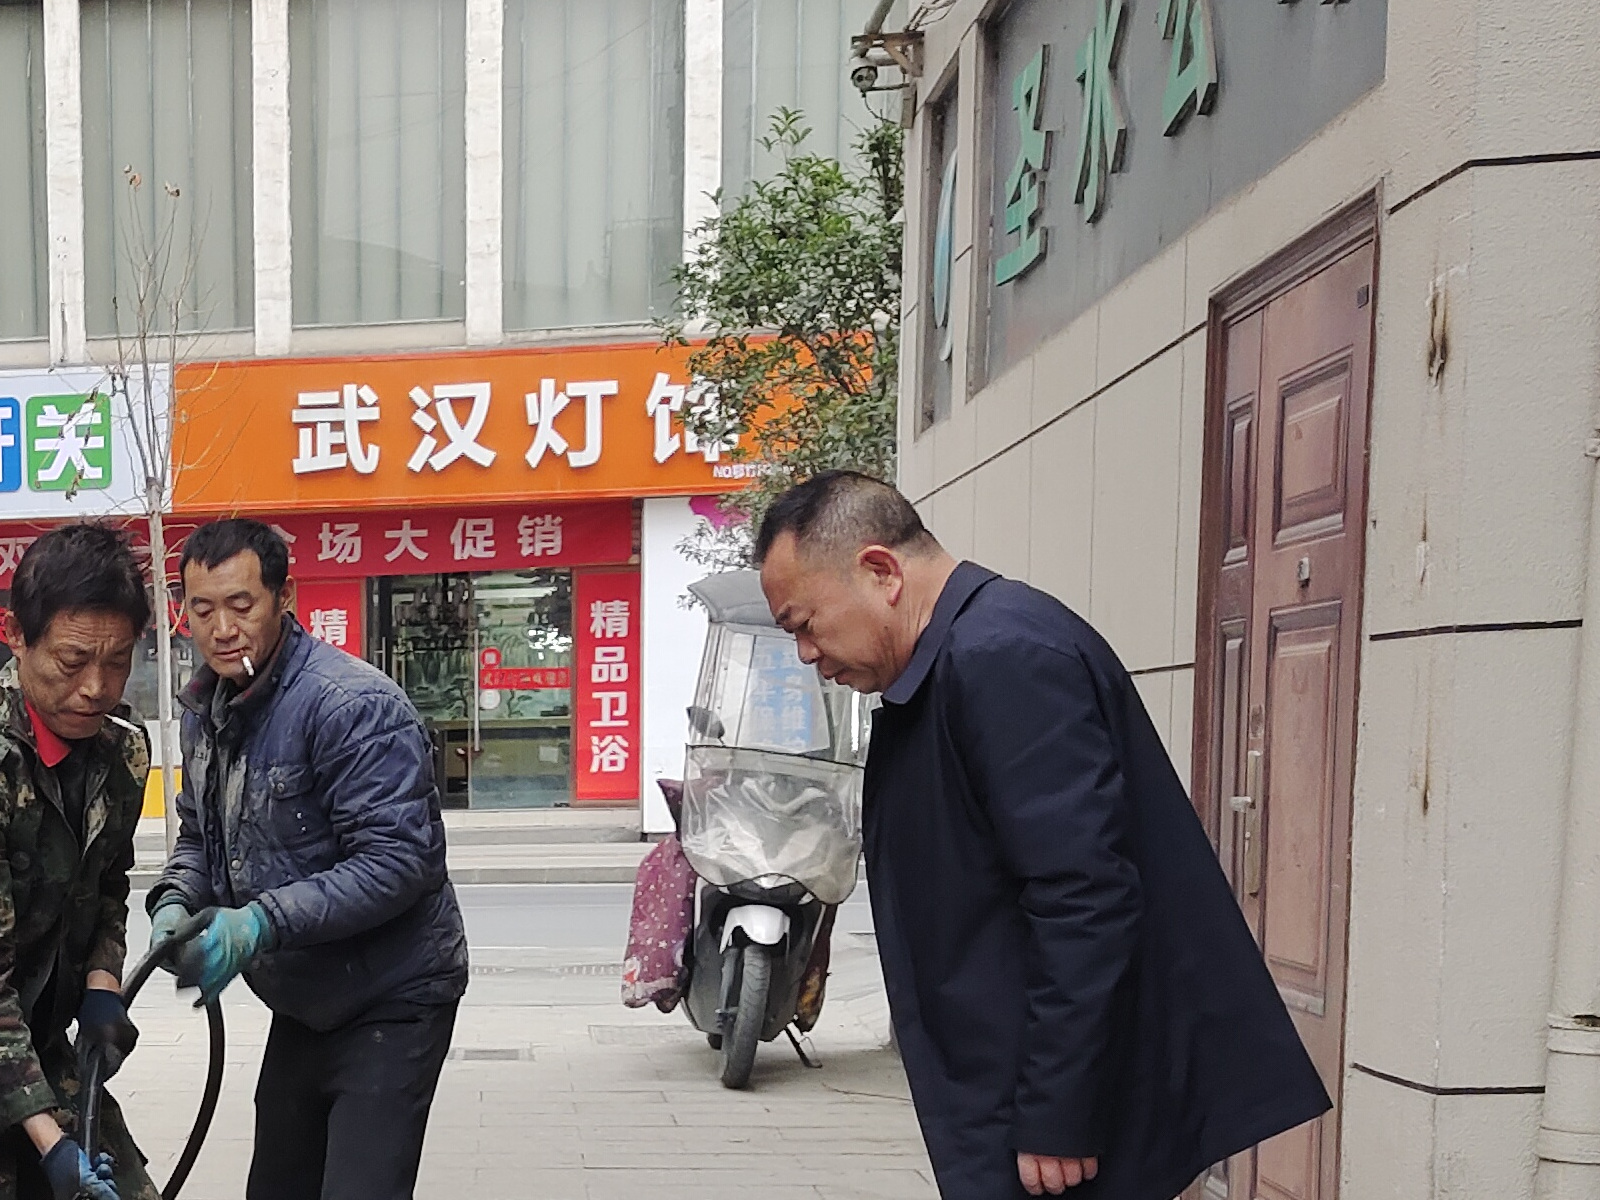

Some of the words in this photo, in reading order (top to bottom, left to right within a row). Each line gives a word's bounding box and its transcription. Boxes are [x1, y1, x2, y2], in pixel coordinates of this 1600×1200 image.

[309, 608, 349, 646] 精
[589, 599, 629, 773] 精品卫浴
